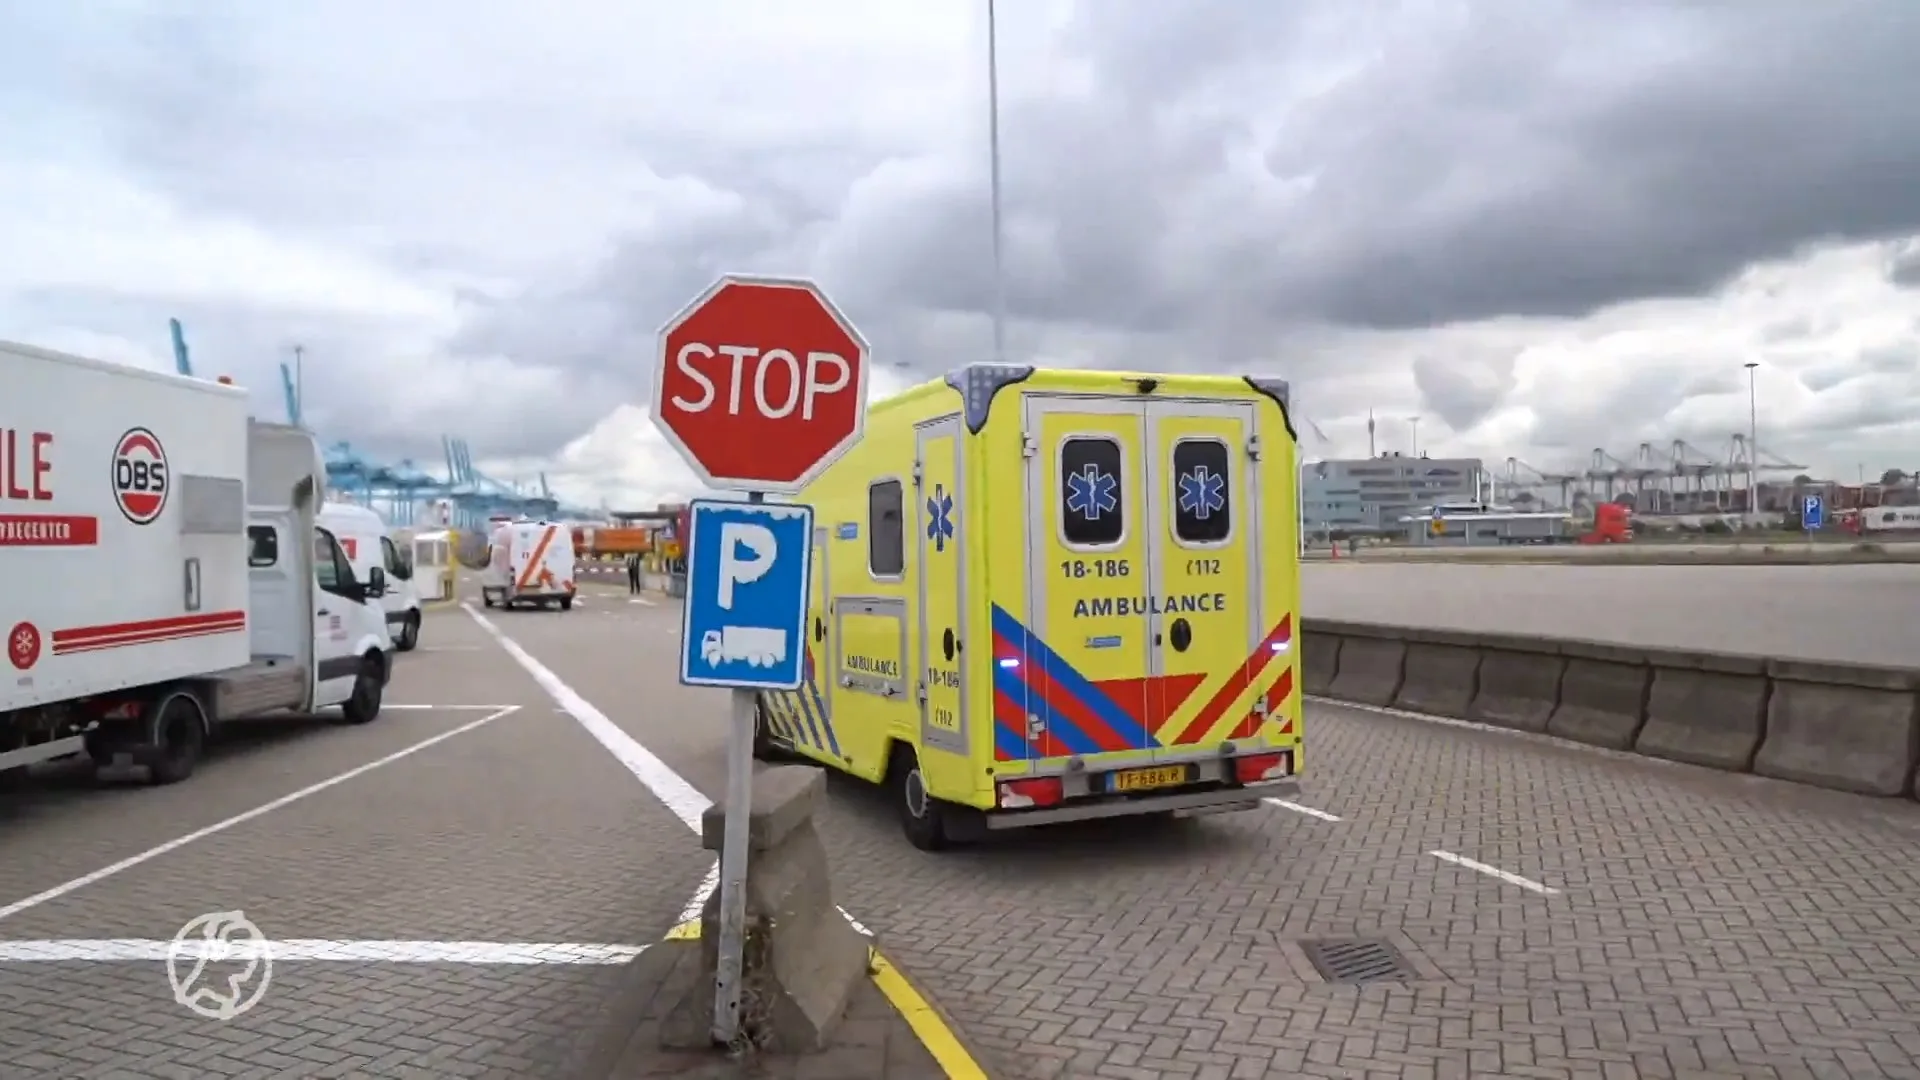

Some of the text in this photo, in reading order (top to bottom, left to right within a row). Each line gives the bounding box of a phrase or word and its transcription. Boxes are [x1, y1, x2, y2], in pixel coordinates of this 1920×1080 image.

[671, 342, 850, 421] STOP
[117, 459, 164, 491] DBS
[717, 522, 778, 610] P
[1061, 559, 1130, 578] 18-186
[1195, 559, 1220, 576] 112
[1073, 593, 1227, 618] AMBULANCE
[847, 654, 898, 676] AMBULANCE
[927, 667, 960, 688] 18-186
